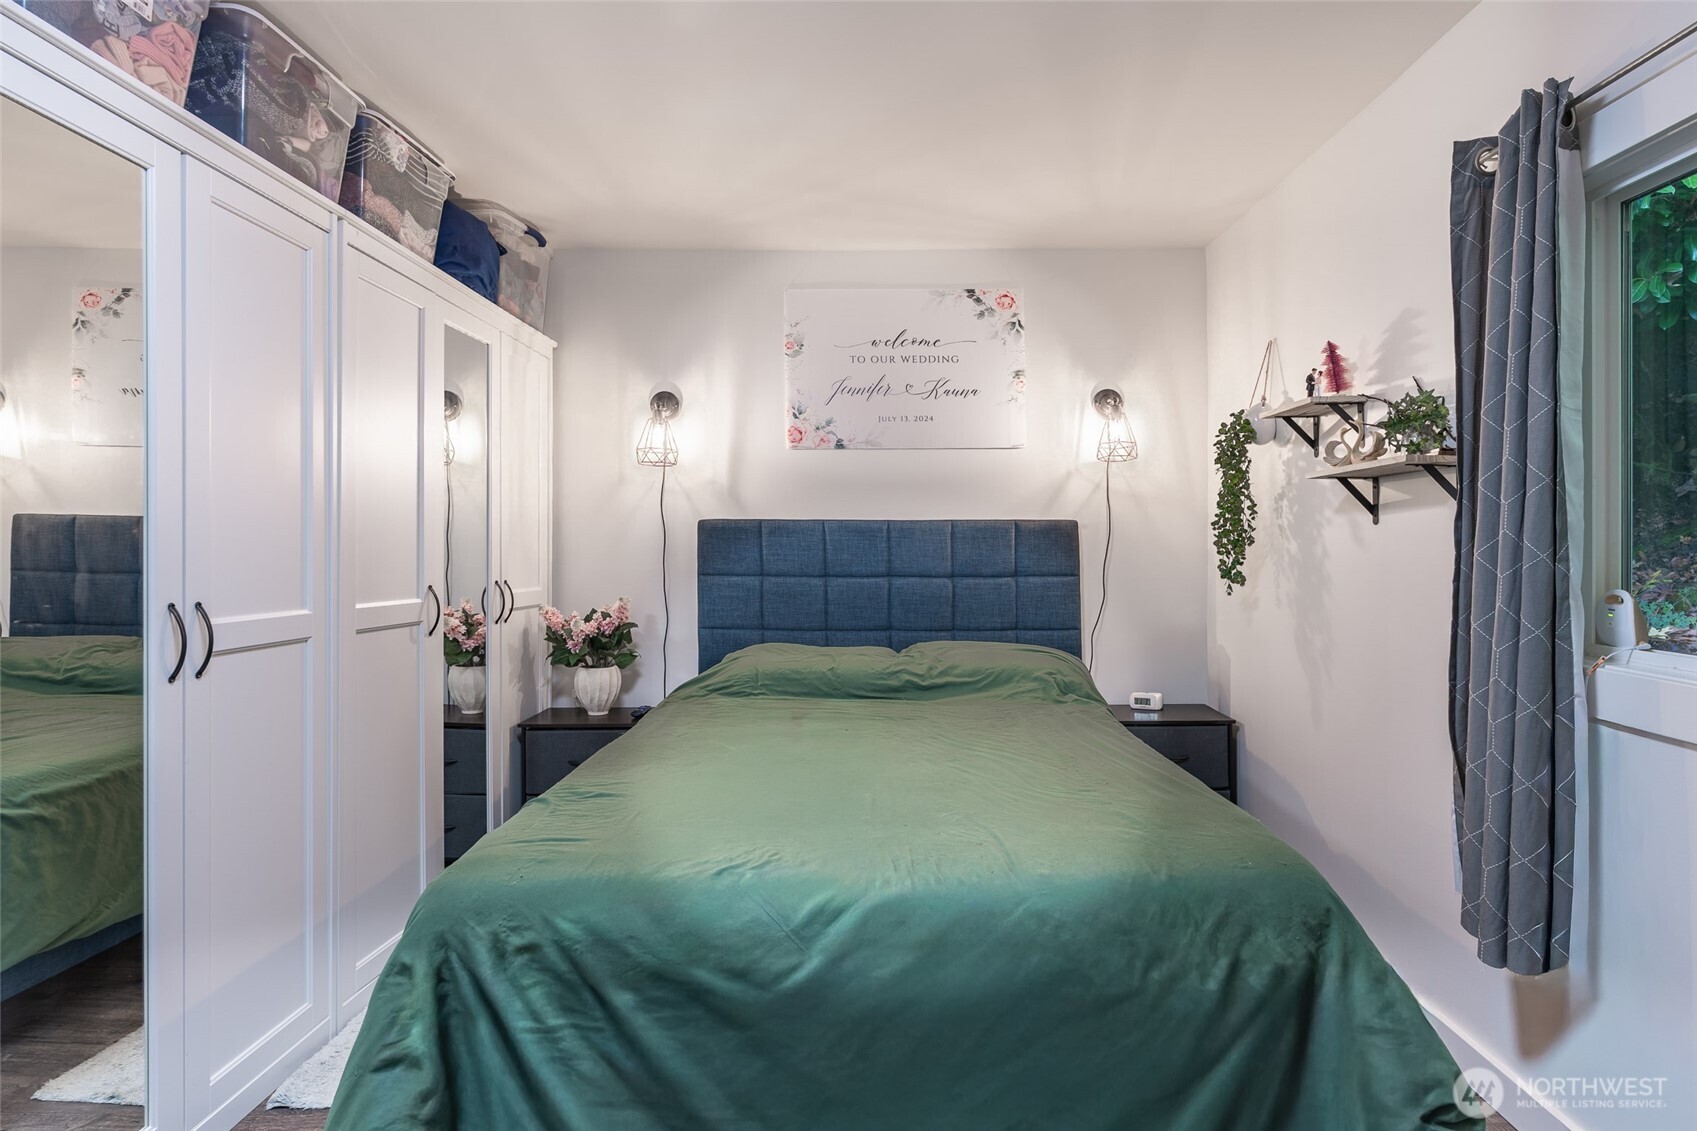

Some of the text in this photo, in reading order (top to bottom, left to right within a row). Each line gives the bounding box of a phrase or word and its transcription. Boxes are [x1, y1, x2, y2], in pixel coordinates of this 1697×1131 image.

[833, 329, 977, 349] welcome
[849, 355, 959, 364] TO OUR WEDDING
[825, 374, 893, 406] Jennifer
[878, 415, 897, 423] JULY
[913, 415, 934, 423] 2024
